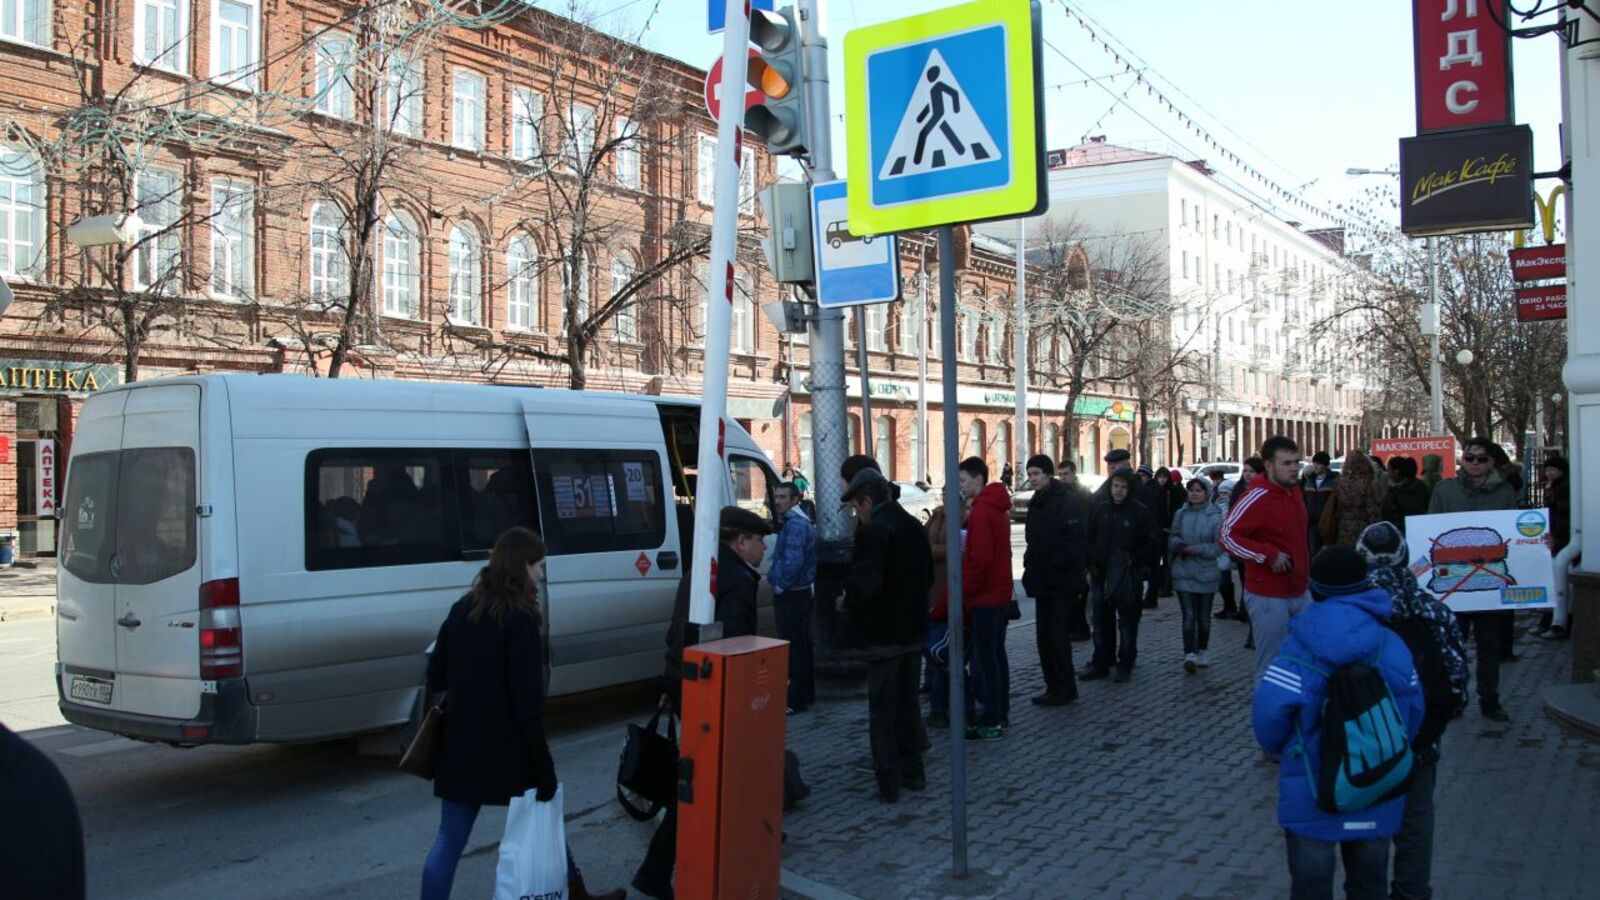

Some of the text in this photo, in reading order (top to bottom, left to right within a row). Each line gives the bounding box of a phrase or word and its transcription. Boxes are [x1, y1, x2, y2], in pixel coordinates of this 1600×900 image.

[1520, 297, 1542, 305] ОКНО
[42, 445, 54, 509] АПТЕКА
[626, 468, 642, 482] 20
[573, 478, 594, 508] 51
